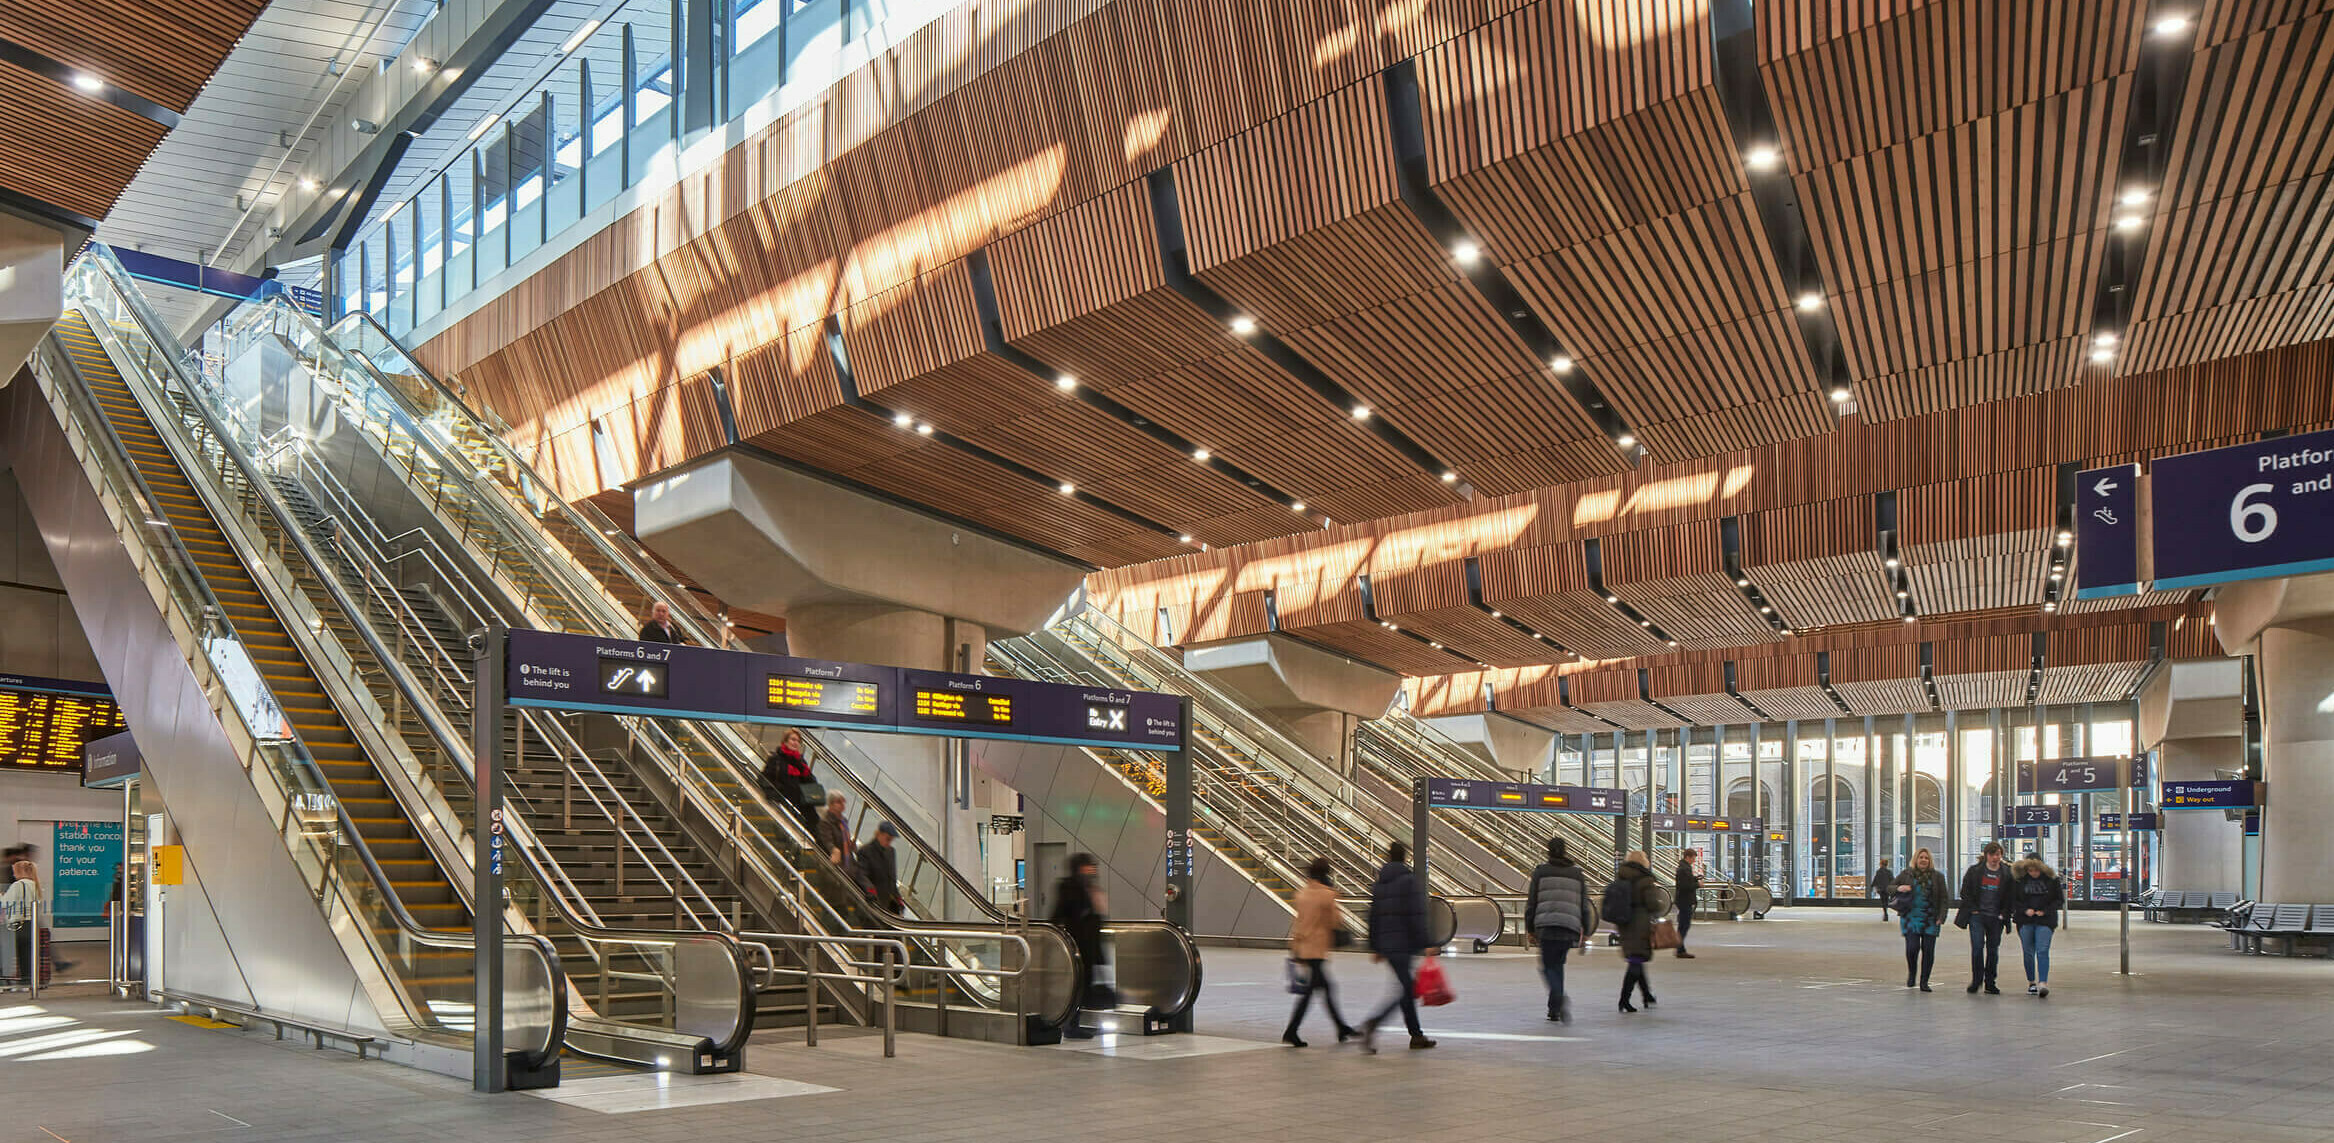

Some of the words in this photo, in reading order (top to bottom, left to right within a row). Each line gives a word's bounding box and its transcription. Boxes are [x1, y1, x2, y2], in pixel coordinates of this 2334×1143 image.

[2230, 483, 2278, 543] 6
[2291, 473, 2332, 494] and
[595, 646, 635, 658] Platforms
[636, 646, 645, 659] 6
[646, 652, 661, 660] and
[662, 649, 671, 660] 7
[531, 665, 548, 675] The
[548, 667, 561, 676] lift
[562, 668, 570, 677] is
[805, 666, 834, 677] Platform
[834, 666, 842, 677] 7
[523, 677, 553, 687] behind
[553, 681, 570, 690] you
[948, 680, 974, 690] Platform
[975, 679, 982, 690] 6
[1083, 693, 1108, 702] Platforms
[1108, 692, 1115, 703] 6
[1125, 694, 1131, 704] 7
[1089, 717, 1108, 728] Entry
[1148, 728, 1165, 736] behind
[2056, 769, 2069, 784] 4
[2083, 767, 2096, 783] 5
[2026, 811, 2034, 821] 2
[2042, 810, 2050, 821] 3
[59, 830, 91, 840] station
[94, 832, 122, 840] conco
[59, 843, 85, 852] thank
[88, 845, 105, 853] you
[59, 855, 73, 864] for
[76, 856, 96, 865] your
